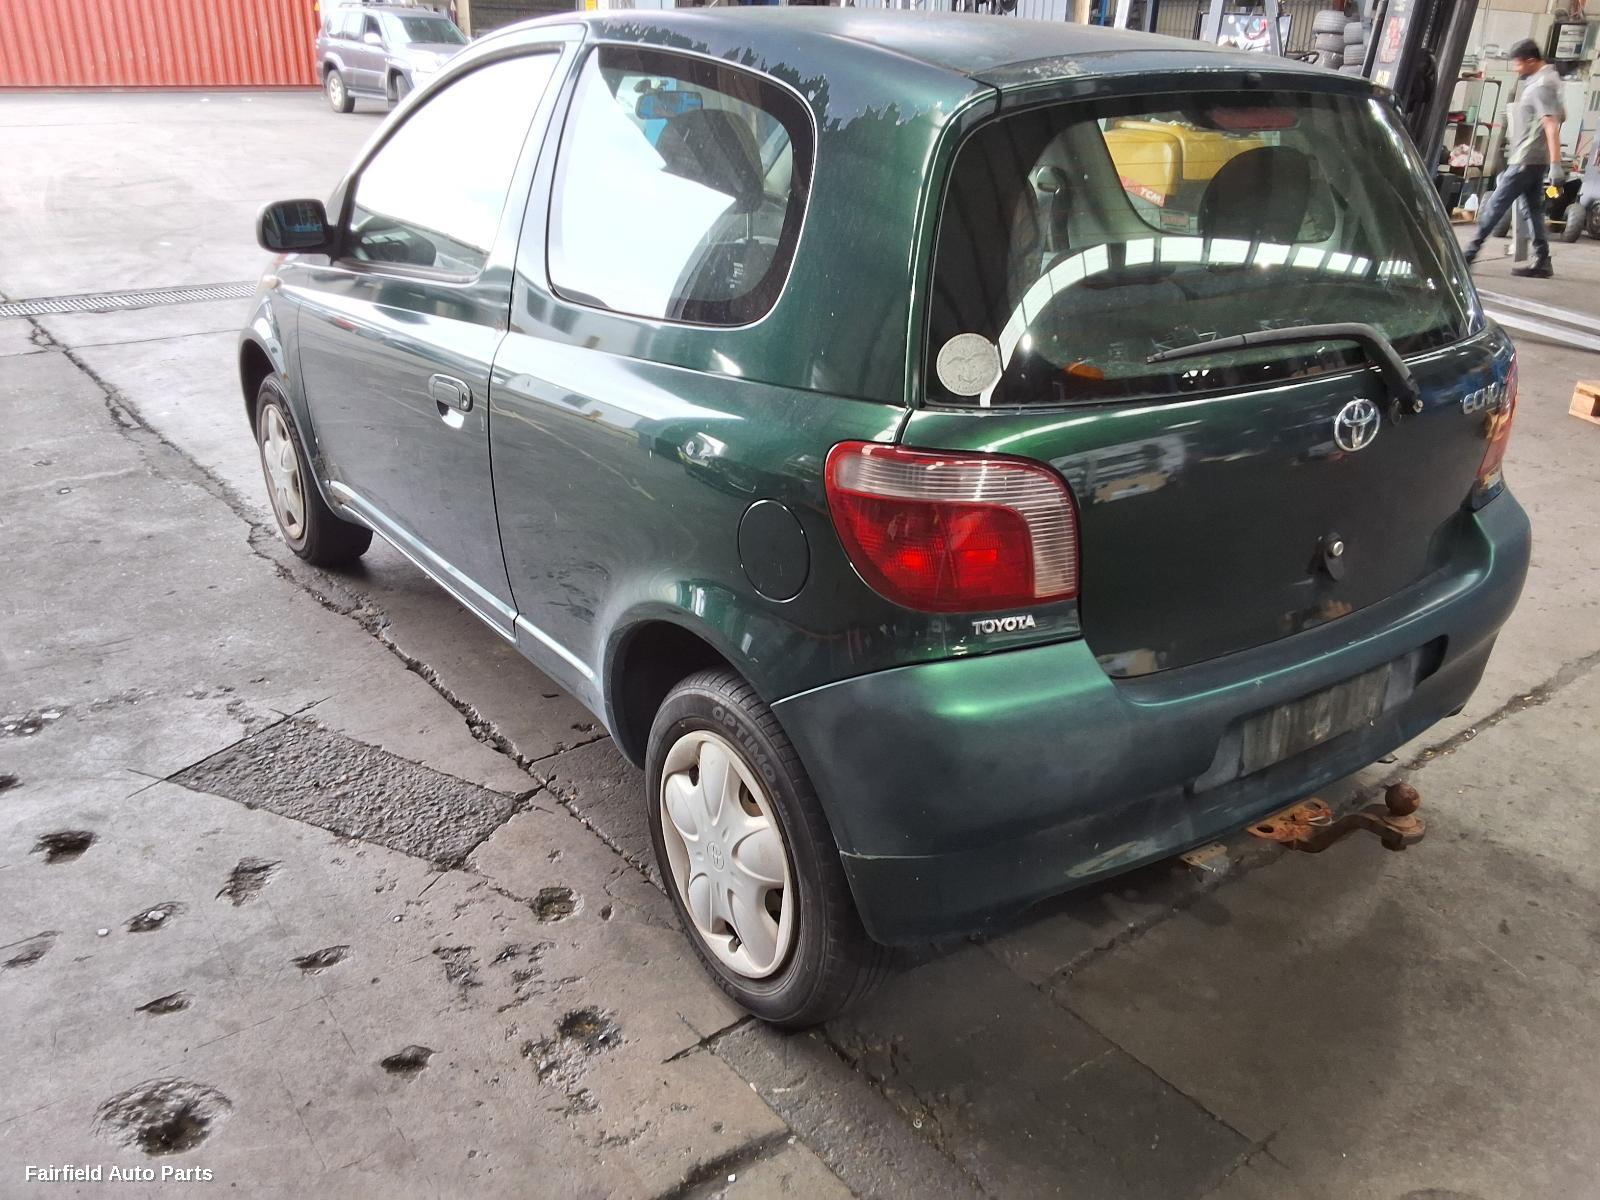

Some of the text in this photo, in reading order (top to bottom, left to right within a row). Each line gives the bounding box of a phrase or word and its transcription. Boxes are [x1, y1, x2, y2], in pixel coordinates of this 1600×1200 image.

[1139, 187, 1162, 205] TCM
[972, 614, 1036, 636] TOYOTA
[712, 705, 776, 783] OPTIMO
